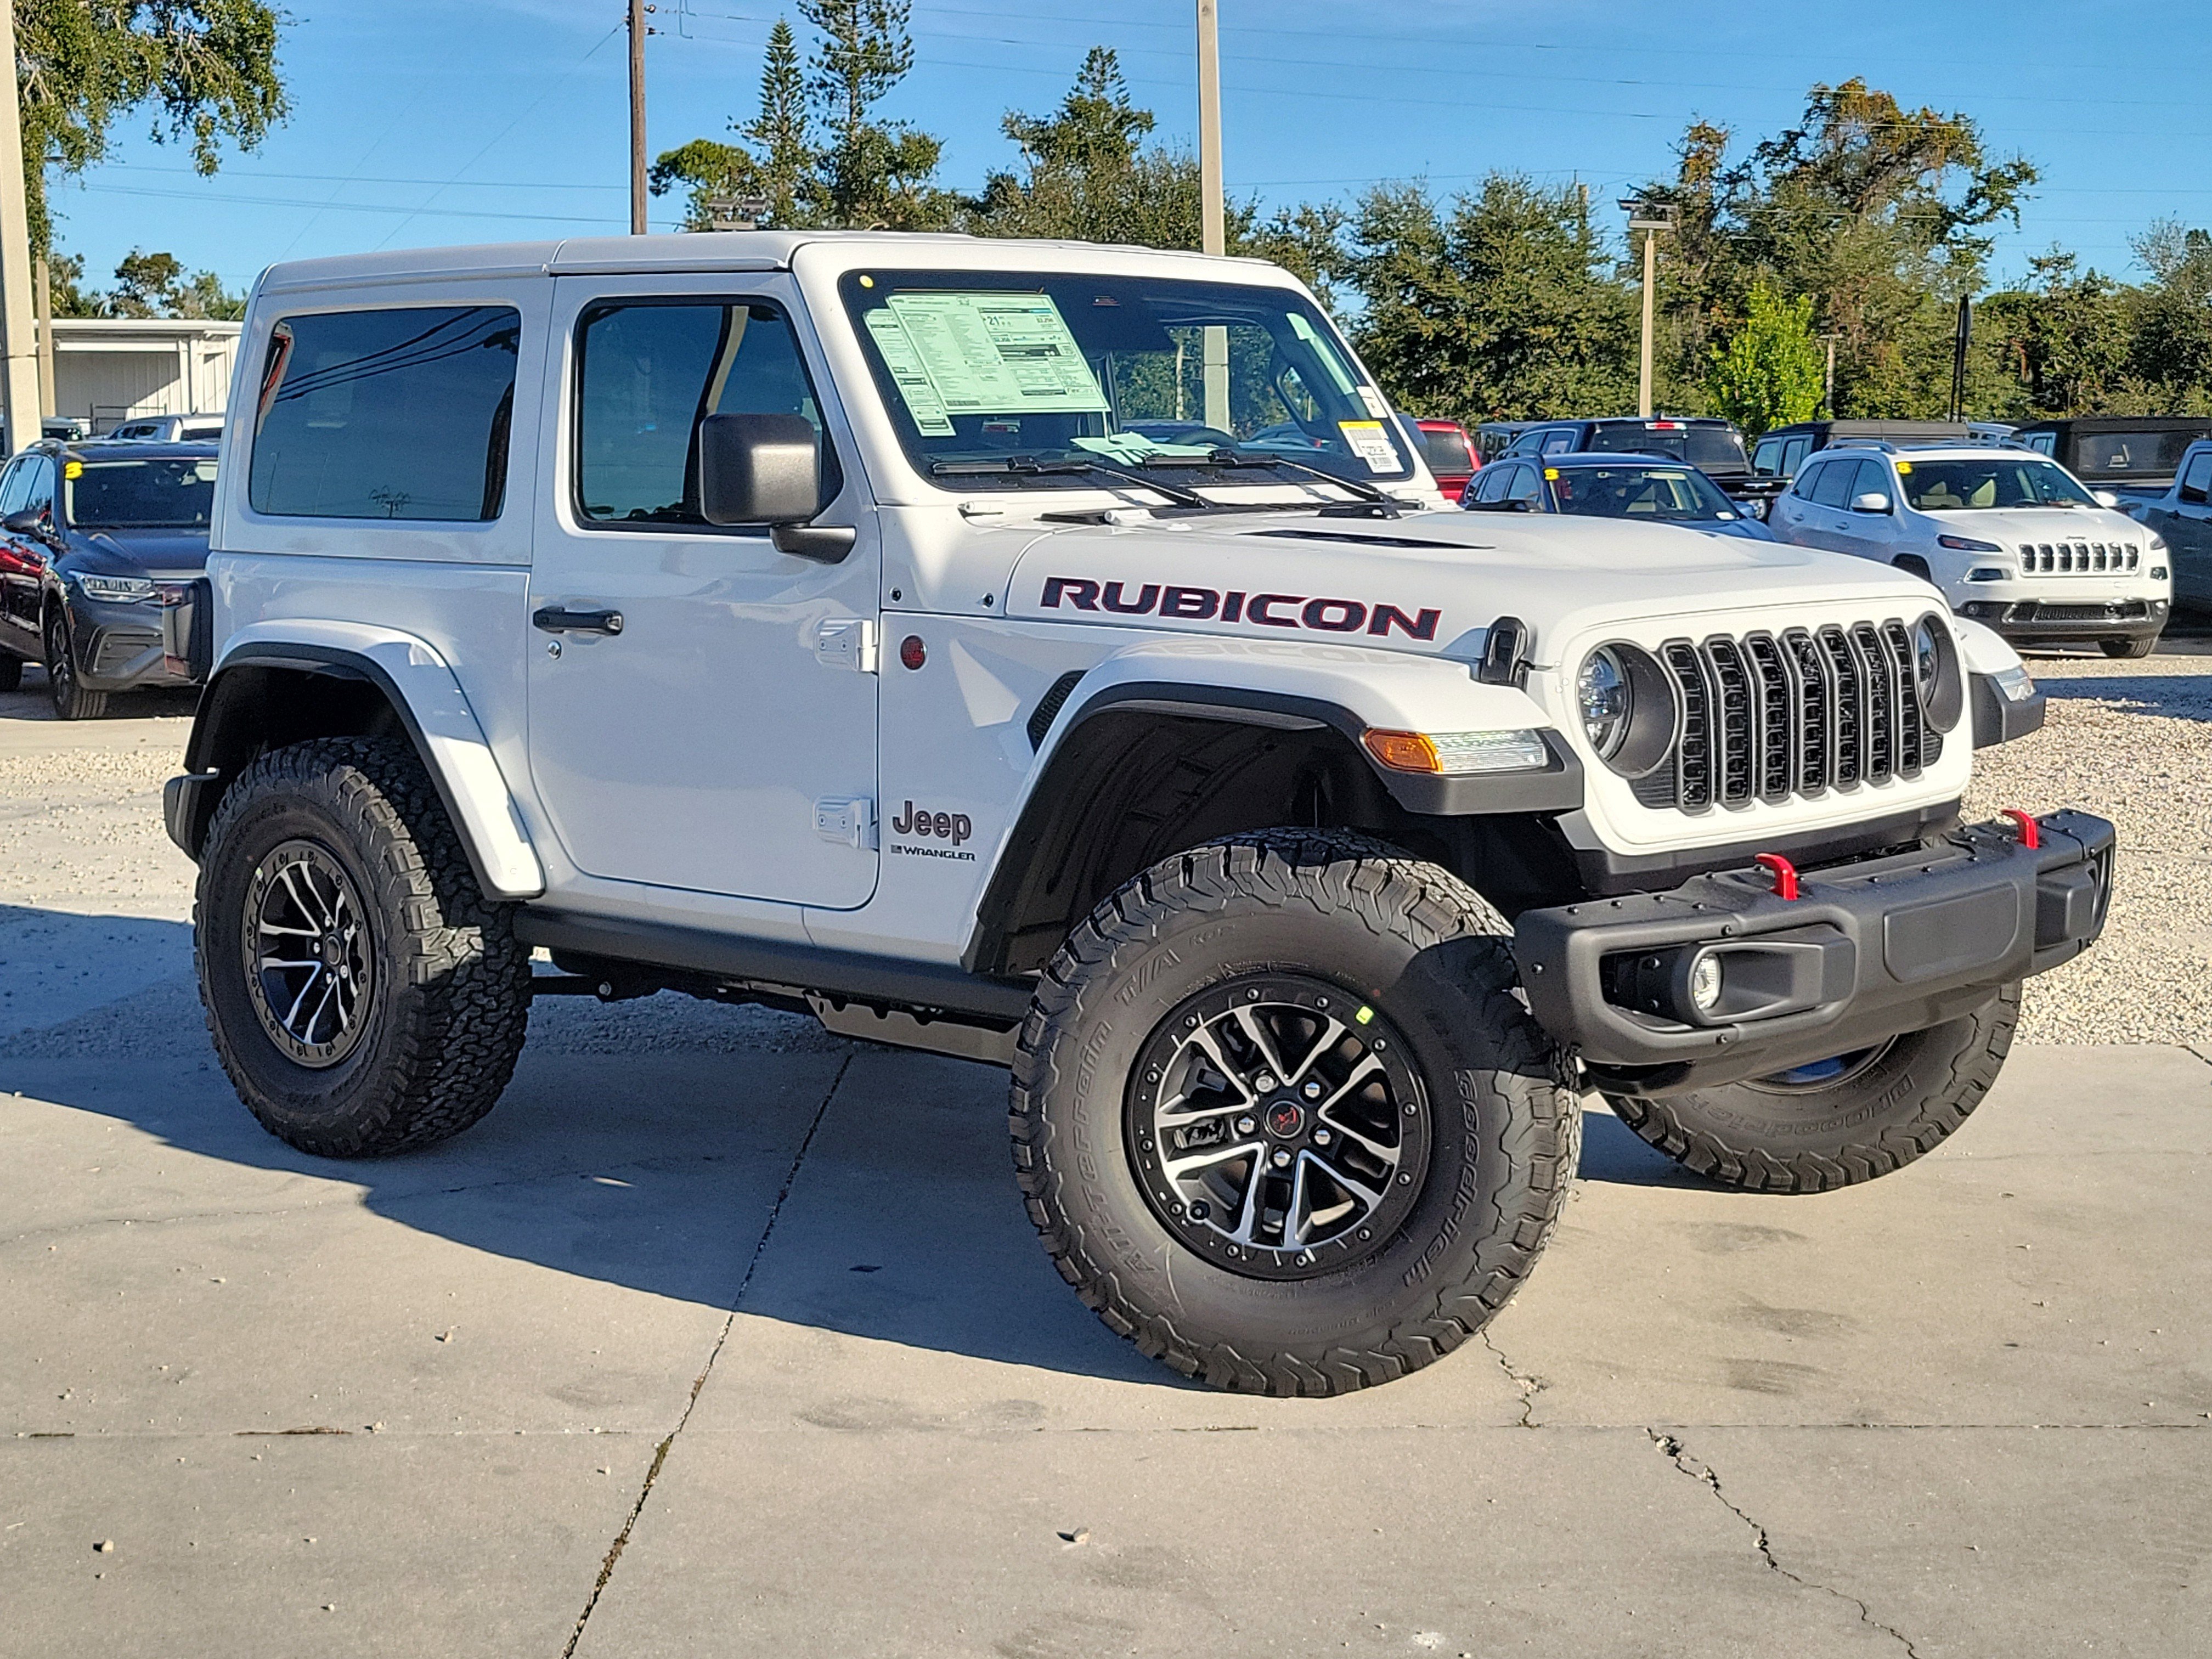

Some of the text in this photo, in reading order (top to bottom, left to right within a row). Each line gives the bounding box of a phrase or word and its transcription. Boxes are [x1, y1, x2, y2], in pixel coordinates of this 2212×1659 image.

[1041, 576, 1443, 642] RUBICON
[892, 800, 972, 847] Jeep
[903, 845, 976, 861] WRANGLER
